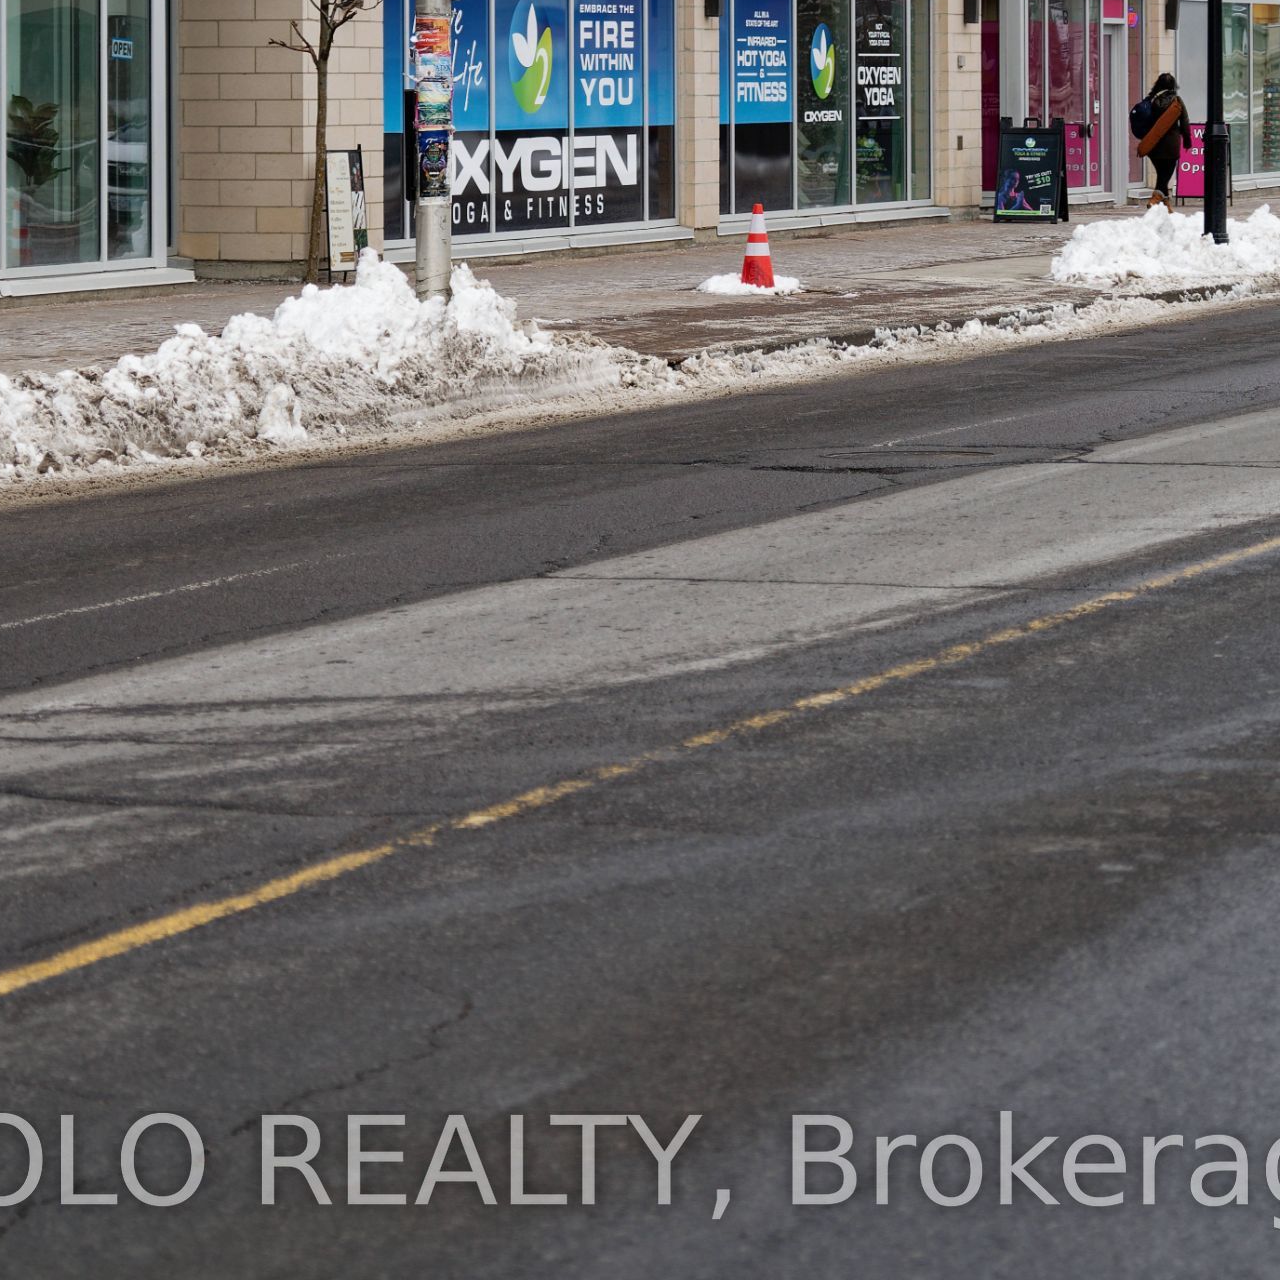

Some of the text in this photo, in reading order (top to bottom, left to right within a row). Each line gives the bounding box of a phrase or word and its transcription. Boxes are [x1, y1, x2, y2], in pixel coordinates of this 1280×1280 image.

[579, 4, 635, 14] EMBRACE THE
[579, 20, 635, 49] FIRE
[747, 36, 777, 47] INFRARED
[113, 41, 132, 57] OPEN
[580, 53, 634, 71] WITHIN
[737, 50, 787, 67] HOT YOGA
[857, 66, 901, 85] OXYGEN
[580, 77, 634, 106] YOU
[737, 81, 787, 102] FITNESS
[864, 87, 895, 106] YOGA
[804, 110, 842, 122] OXYGEN
[1191, 147, 1205, 155] ar
[452, 134, 638, 196] XYGEN
[1181, 162, 1205, 174] Op
[452, 193, 604, 224] OGA & FITNESS
